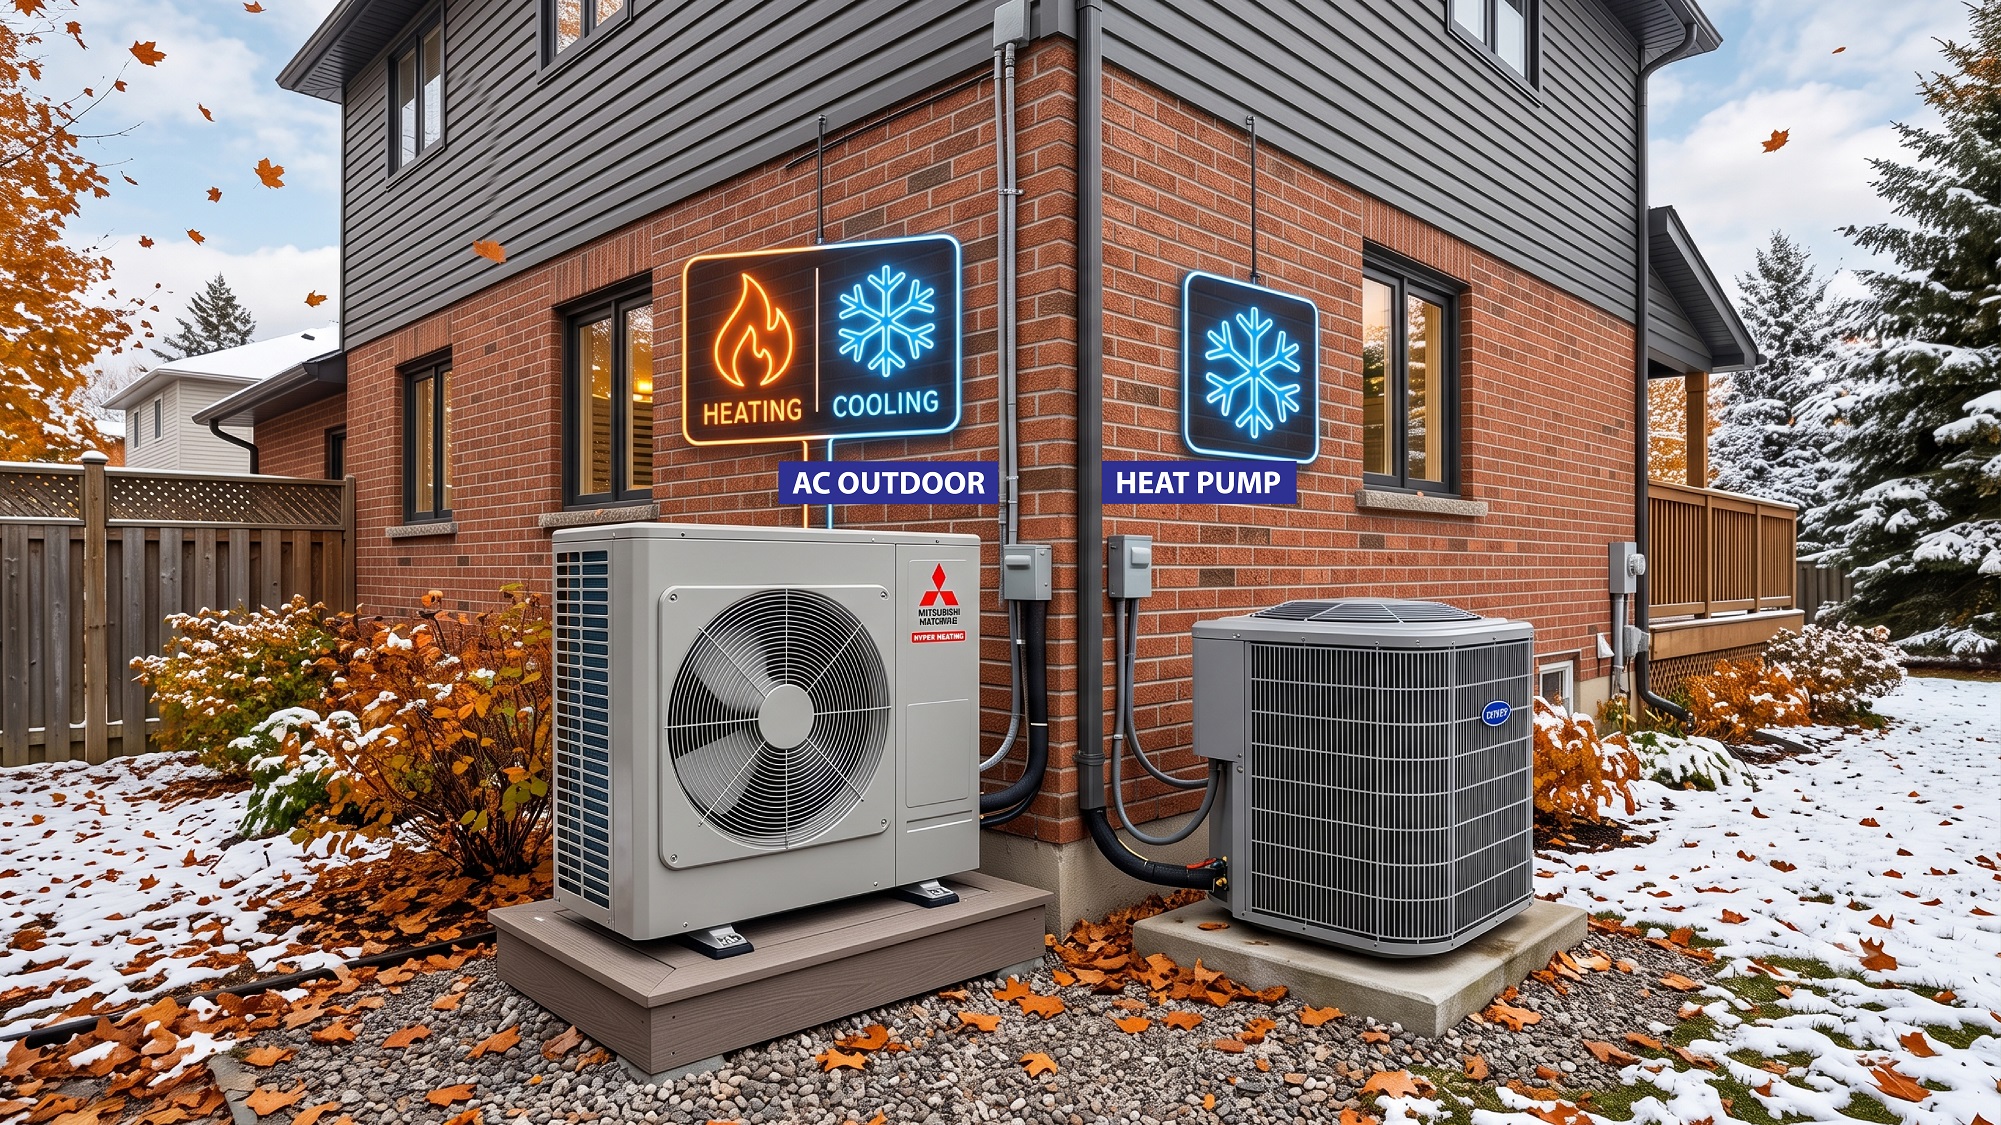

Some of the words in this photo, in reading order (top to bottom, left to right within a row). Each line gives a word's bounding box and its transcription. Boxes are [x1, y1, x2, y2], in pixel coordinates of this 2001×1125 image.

[702, 398, 802, 426] HEATING
[832, 389, 939, 418] COOLING
[918, 608, 961, 617] MITSUBISHI
